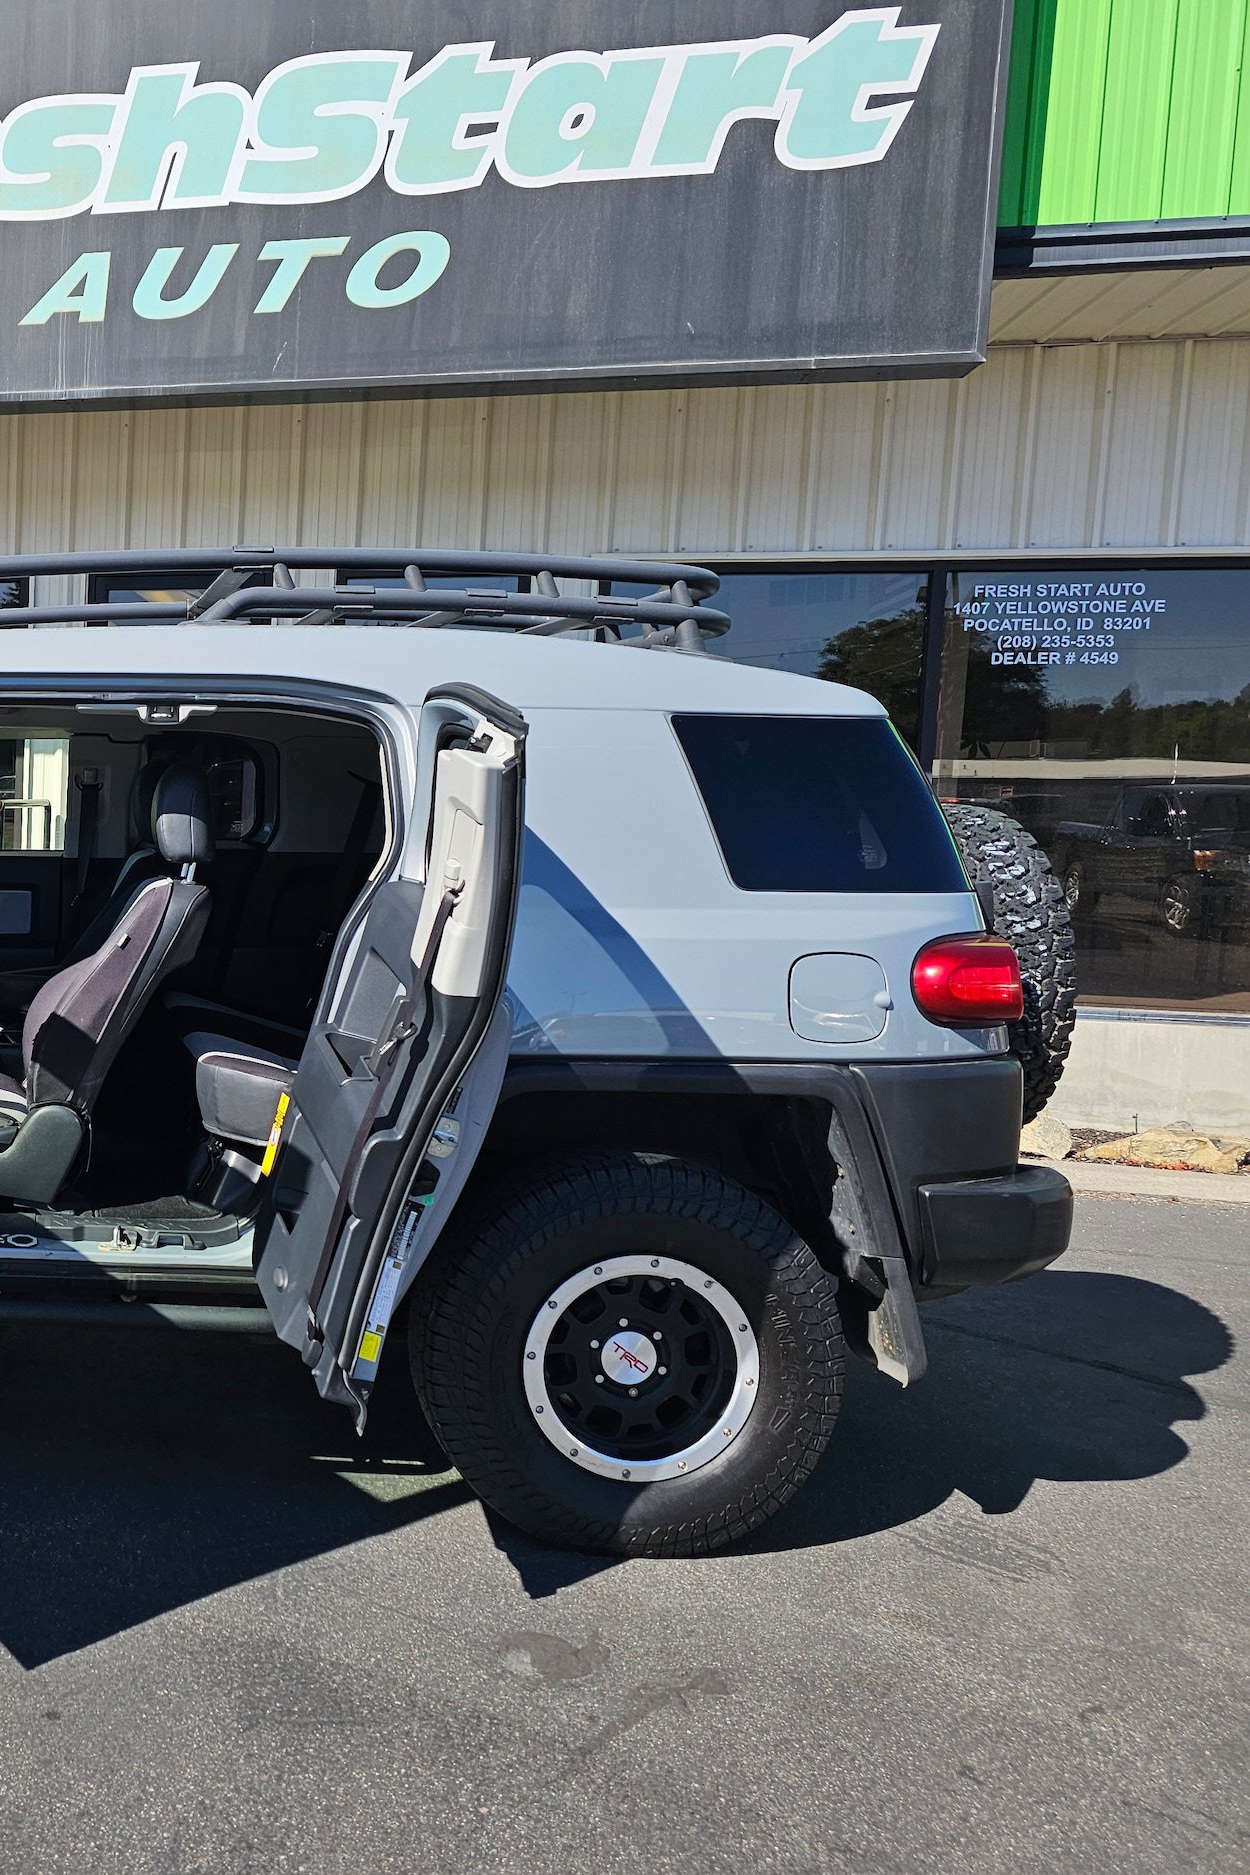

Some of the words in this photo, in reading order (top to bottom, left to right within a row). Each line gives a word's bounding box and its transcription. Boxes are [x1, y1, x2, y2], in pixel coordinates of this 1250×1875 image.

[19, 229, 451, 327] AUTO
[974, 584, 1031, 597] FRESH
[1036, 583, 1092, 597] START
[1096, 582, 1146, 596] AUTO
[953, 602, 989, 615] 1407
[995, 601, 1126, 614] YELLOWSTONE
[1131, 600, 1166, 613] AVE
[963, 619, 1071, 633] POCATELLO,
[1076, 618, 1094, 631] ID
[1103, 617, 1151, 630] 83201
[997, 635, 1037, 650] (208)
[1041, 635, 1115, 648] 235-5353
[991, 652, 1061, 665] DEALER
[1065, 652, 1076, 664] #
[1079, 652, 1119, 665] 4549
[613, 1341, 648, 1374] TRD
